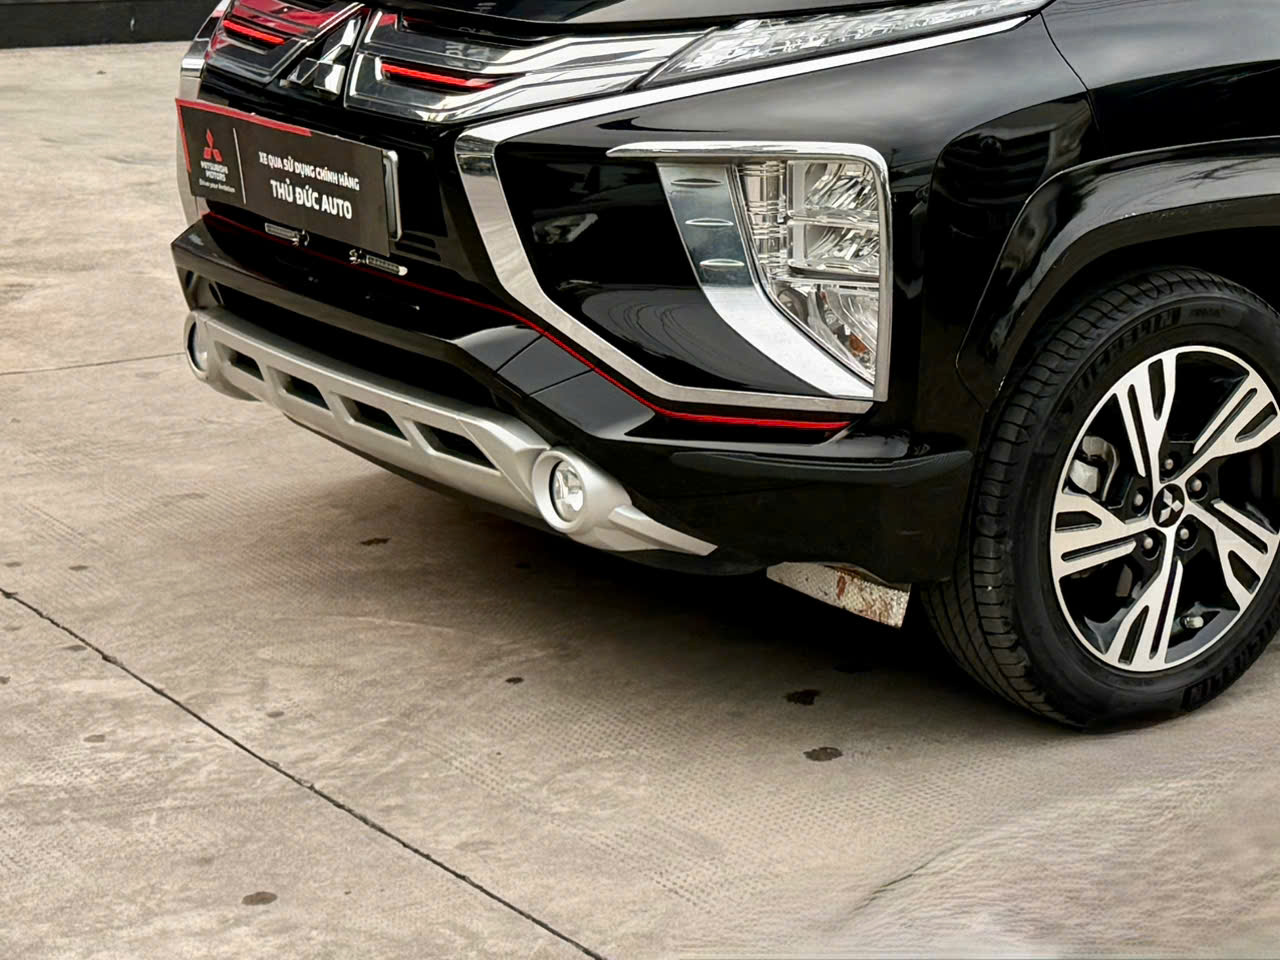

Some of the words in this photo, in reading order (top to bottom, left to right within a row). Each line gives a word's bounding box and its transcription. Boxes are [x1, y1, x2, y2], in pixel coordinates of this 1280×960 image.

[259, 151, 268, 166] XE
[268, 154, 283, 170] QUA
[294, 162, 316, 179] DỤNG
[315, 165, 338, 185] CHÍNH
[338, 172, 360, 191] HÃNG
[270, 178, 293, 203] THỦ
[295, 184, 320, 211] ĐỨC
[321, 194, 352, 219] AUTO
